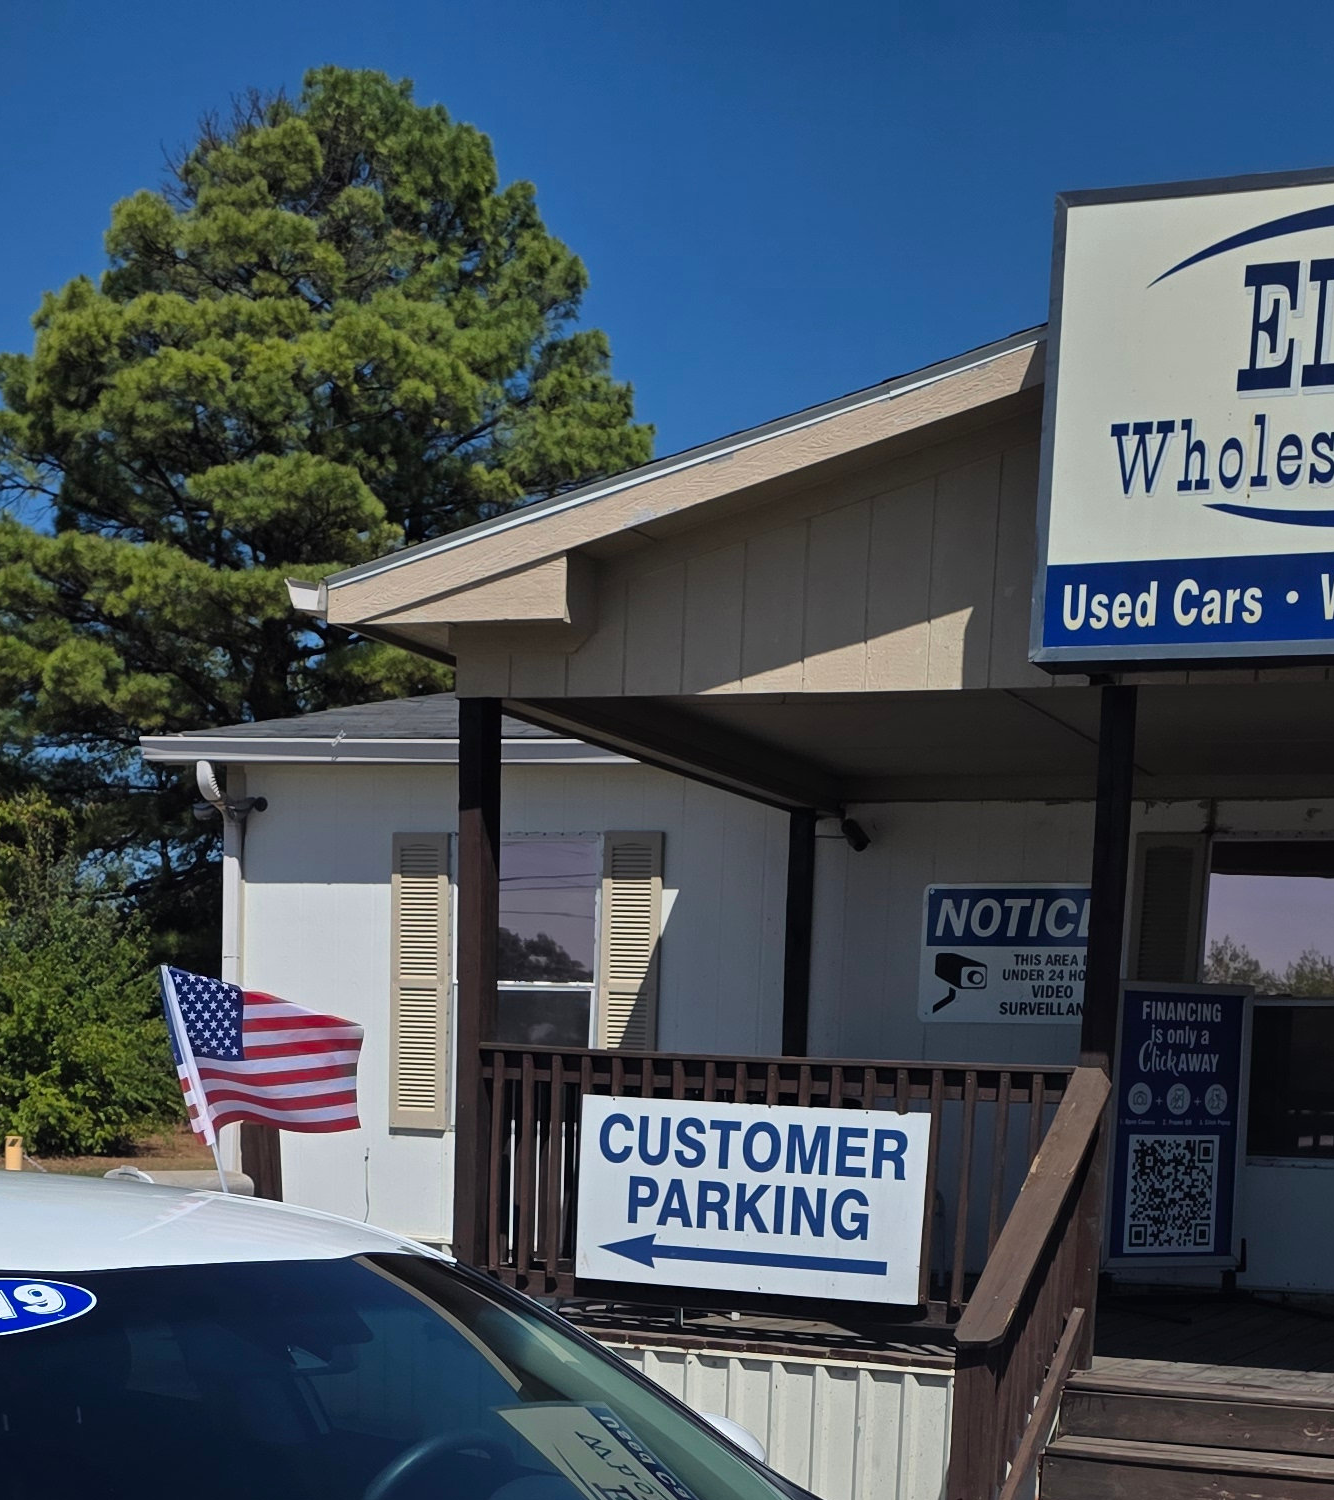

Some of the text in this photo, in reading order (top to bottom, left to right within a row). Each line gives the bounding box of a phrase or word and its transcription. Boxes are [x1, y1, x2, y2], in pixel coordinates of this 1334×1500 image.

[1062, 579, 1157, 630] Used
[1172, 577, 1264, 627] Cars
[1013, 953, 1042, 967] THIS
[1045, 953, 1079, 967] AREA
[1002, 969, 1086, 982] UNDER 24 HO
[1031, 984, 1074, 999] VIDEO
[998, 1001, 1084, 1016] SURVEILLAN
[1142, 1000, 1222, 1023] FINANCING
[1151, 1023, 1210, 1049] is only a
[598, 1112, 908, 1181] CUSTOMER
[627, 1175, 870, 1241] PARKING
